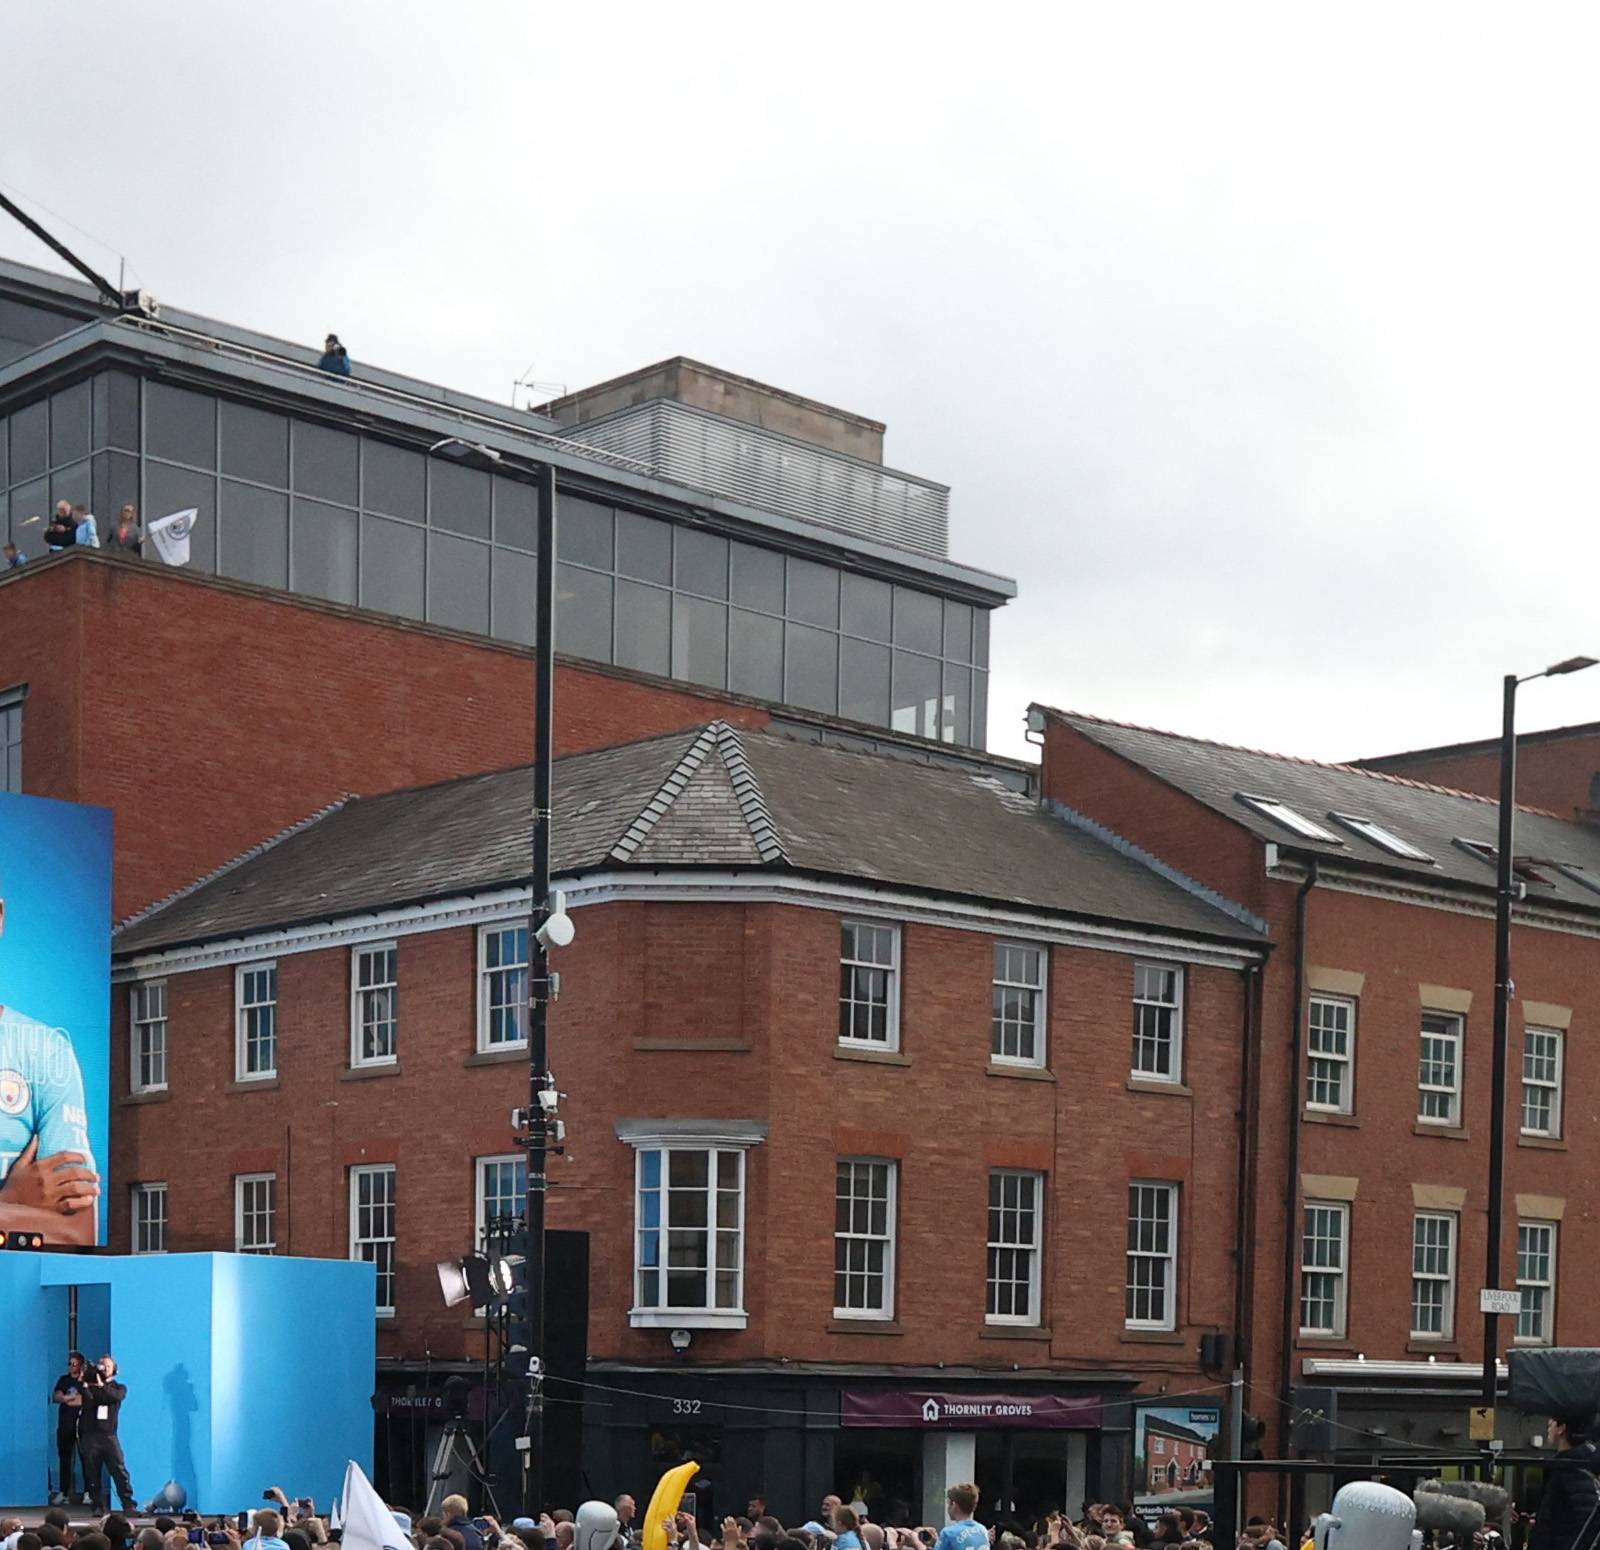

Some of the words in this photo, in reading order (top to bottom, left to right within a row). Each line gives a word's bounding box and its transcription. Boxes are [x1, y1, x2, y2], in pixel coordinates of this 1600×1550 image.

[673, 1399, 702, 1414] 332
[943, 1404, 992, 1416] THORNLEY
[995, 1405, 1032, 1416] GROVES
